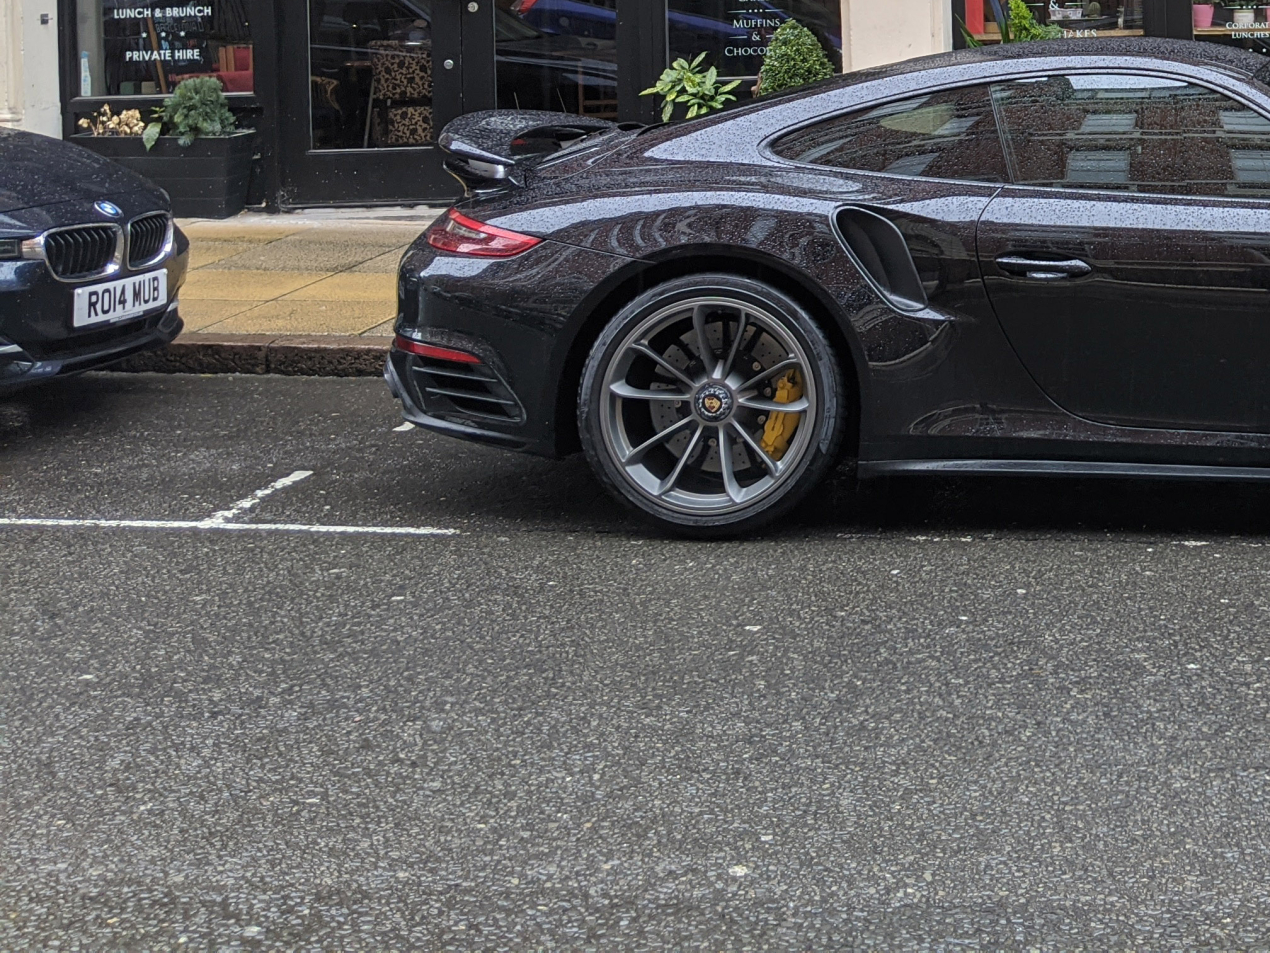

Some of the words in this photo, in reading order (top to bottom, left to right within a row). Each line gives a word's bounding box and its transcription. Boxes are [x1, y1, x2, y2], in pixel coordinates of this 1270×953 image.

[1049, 0, 1059, 9] &
[114, 8, 152, 19] LUNCH
[154, 9, 162, 18] &
[166, 6, 212, 17] BRUNCH
[732, 18, 780, 28] MUFFINS
[752, 32, 761, 41] &
[1232, 31, 1270, 39] LUNCHES
[126, 50, 172, 62] PRIVATE
[174, 49, 200, 60] HIRE
[724, 46, 771, 56] CHOCOL
[88, 283, 127, 318] RO14
[132, 276, 160, 308] MUB
